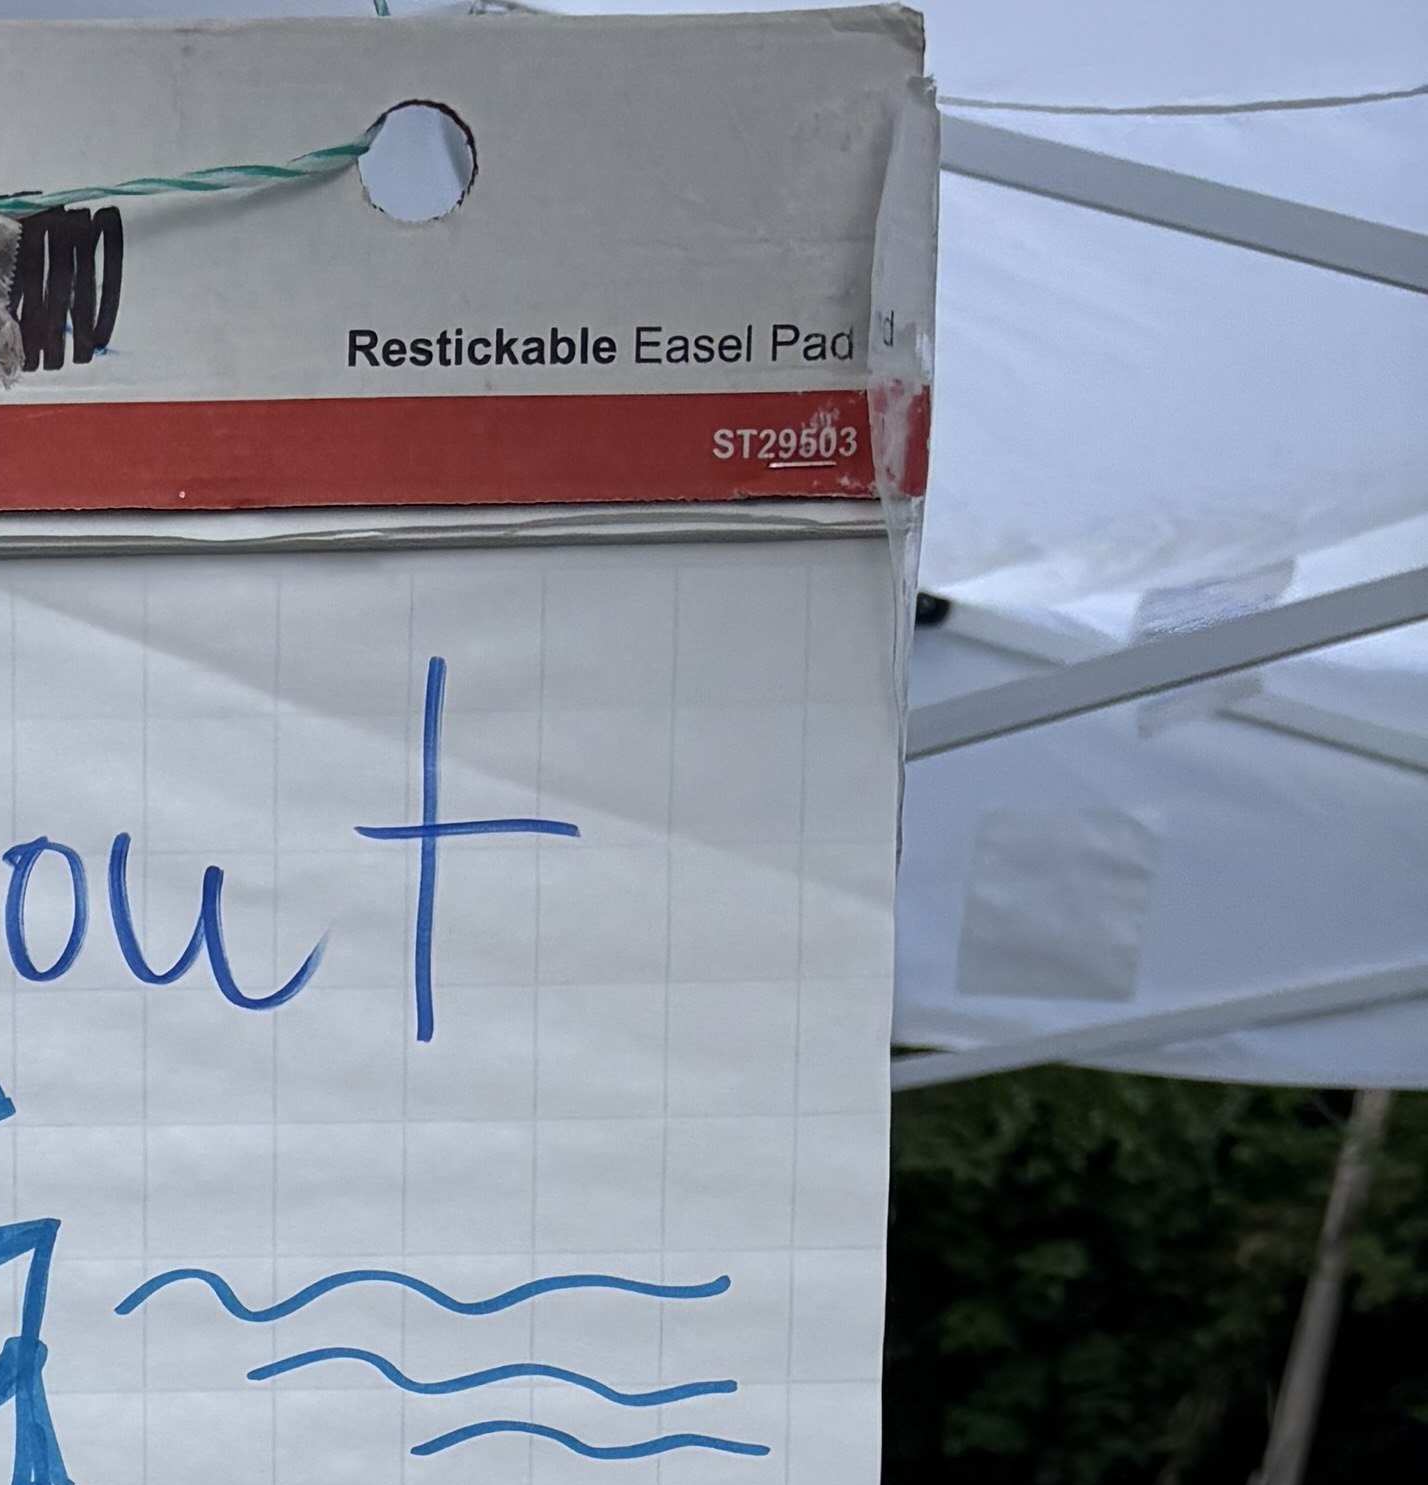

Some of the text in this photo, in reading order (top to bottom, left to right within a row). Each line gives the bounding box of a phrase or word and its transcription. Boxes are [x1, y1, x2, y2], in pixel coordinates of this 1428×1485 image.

[347, 323, 855, 368] Restickable Easel Pad
[712, 426, 859, 461] ST29503
